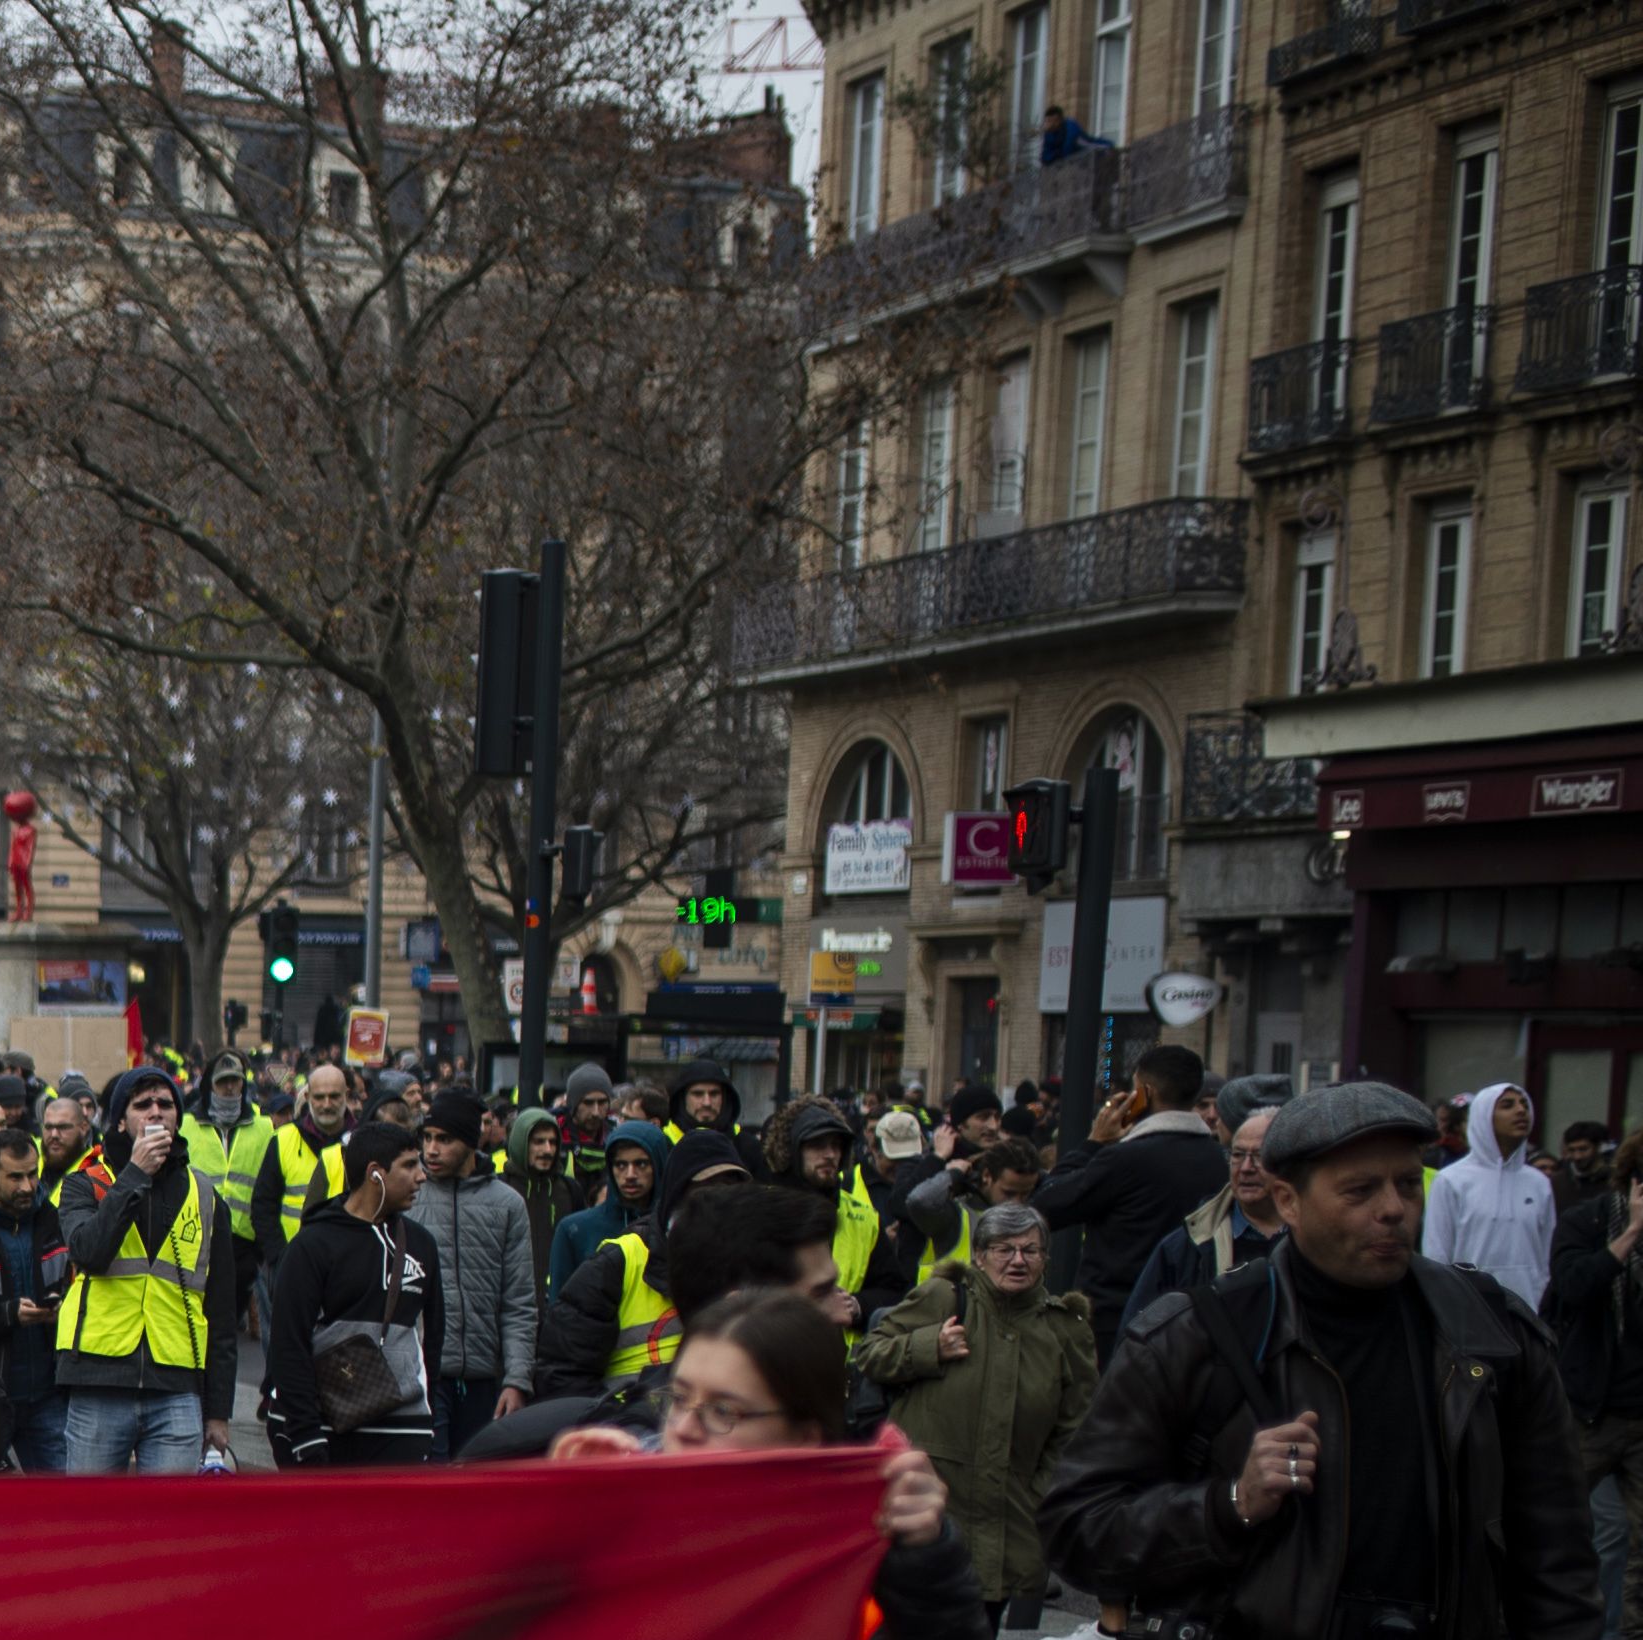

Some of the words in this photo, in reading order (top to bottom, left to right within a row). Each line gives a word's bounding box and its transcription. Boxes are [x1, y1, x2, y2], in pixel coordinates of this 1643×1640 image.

[1540, 775, 1616, 809] Wrangler
[1331, 796, 1361, 823] Lee
[831, 830, 868, 856] Family
[1161, 986, 1214, 1003] Casino
